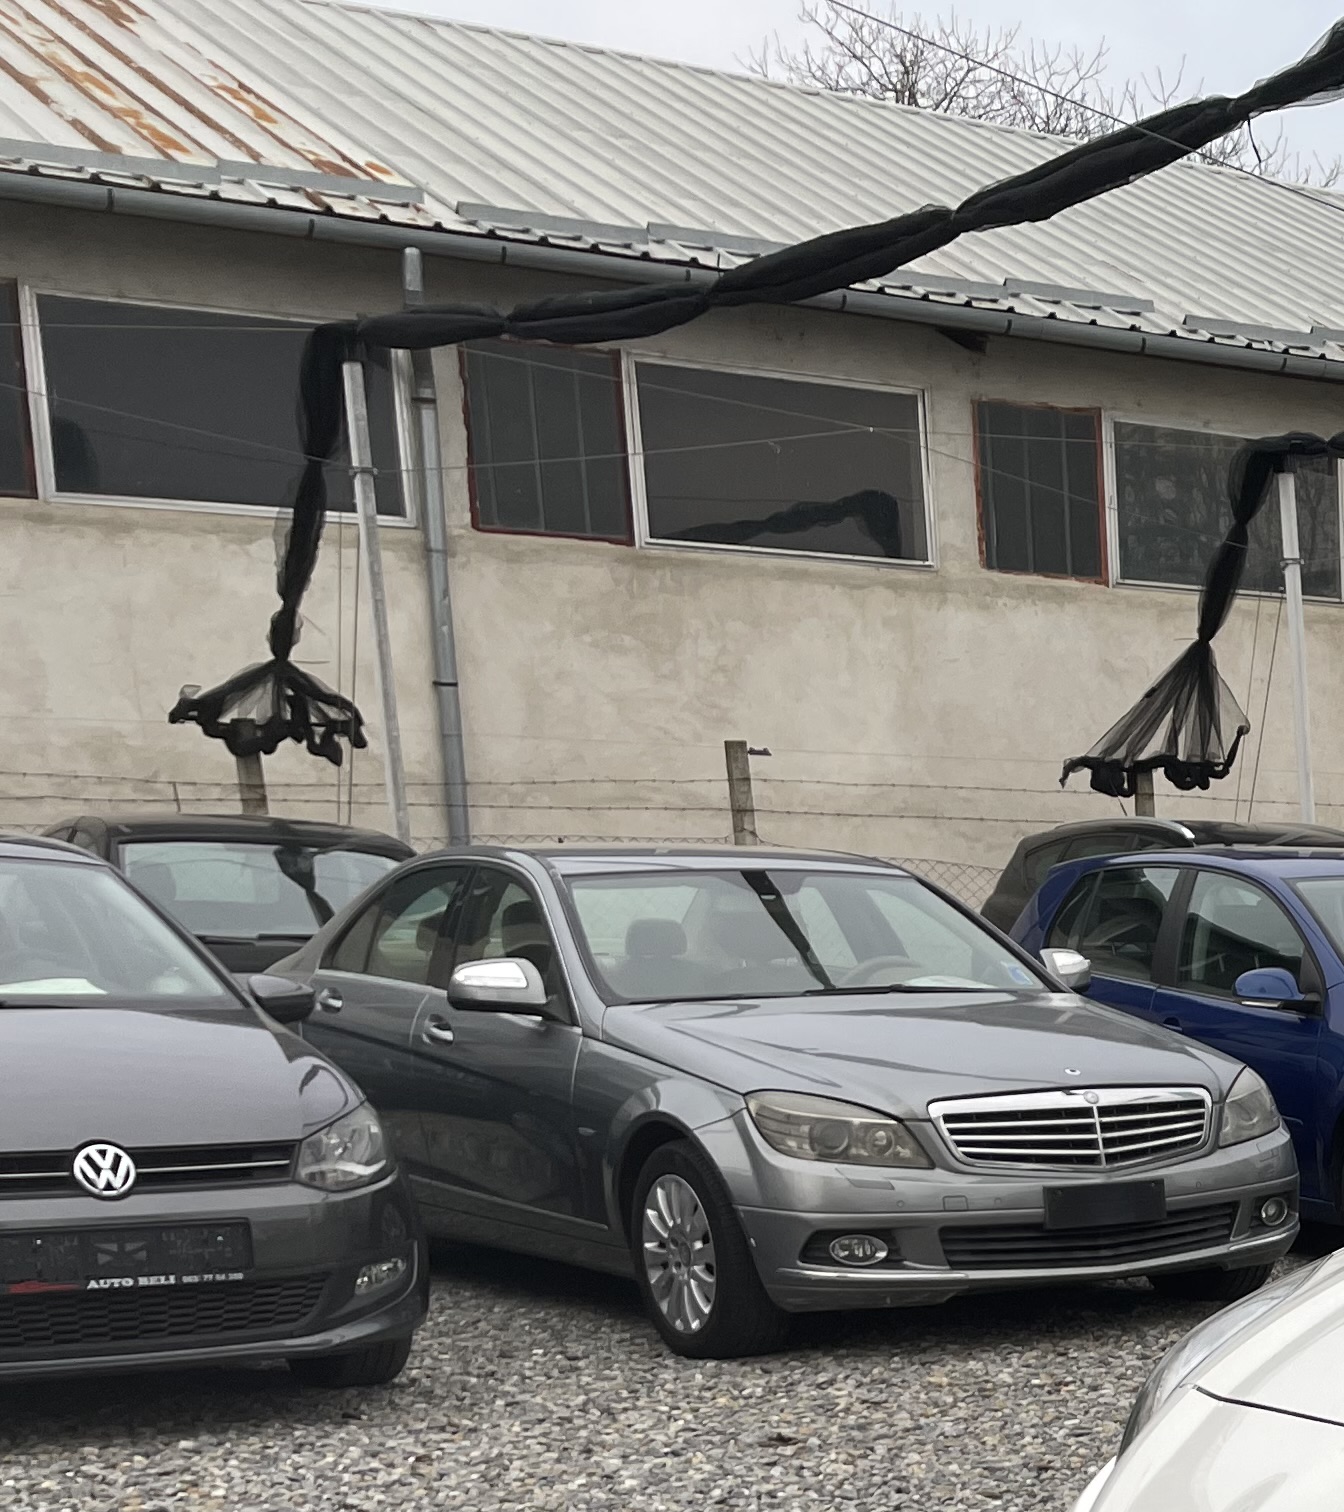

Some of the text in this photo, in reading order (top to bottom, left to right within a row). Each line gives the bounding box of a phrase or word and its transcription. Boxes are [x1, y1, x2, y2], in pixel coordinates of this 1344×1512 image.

[74, 1144, 135, 1196] VW
[87, 1278, 135, 1290] AUTO
[137, 1274, 176, 1287] BELI
